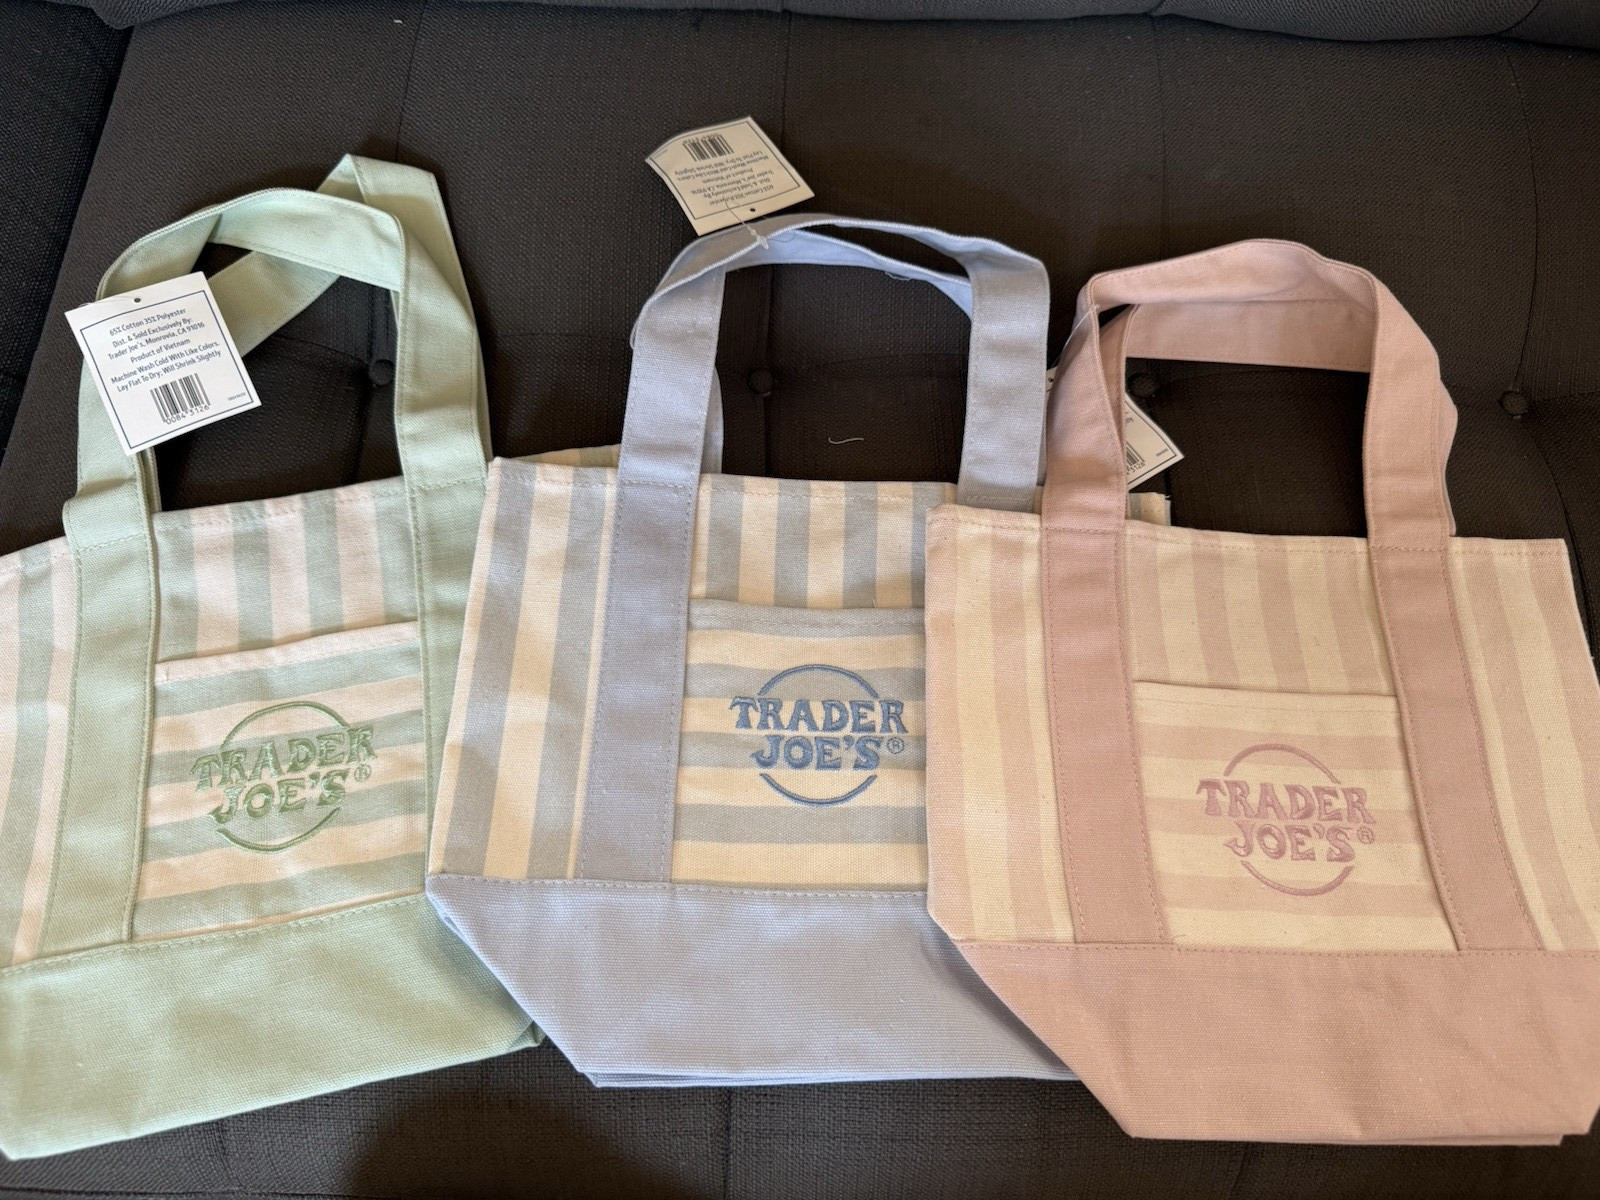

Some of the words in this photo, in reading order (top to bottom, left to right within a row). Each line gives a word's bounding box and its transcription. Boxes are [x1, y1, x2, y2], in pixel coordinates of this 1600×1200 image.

[732, 168, 753, 177] Product
[108, 349, 127, 360] Trader
[128, 342, 146, 353] Joe's,
[145, 332, 178, 345] Monrovia,
[186, 322, 205, 332] 91016
[109, 326, 122, 336] 65%
[121, 321, 144, 331] Cotton
[144, 316, 157, 324] 35%
[156, 309, 186, 320] Polyester
[112, 339, 127, 348] Dist.
[132, 330, 148, 339] Sold
[147, 321, 182, 335] Exclusively
[111, 370, 137, 384] Machine
[137, 363, 155, 373] Wash
[154, 357, 169, 366] Cold
[168, 352, 185, 361] With
[184, 348, 198, 356] Like
[198, 342, 220, 351] Colors.
[130, 350, 156, 363] Product
[156, 346, 163, 354] of
[163, 339, 191, 350] Vietnam
[117, 384, 129, 392] Lay
[128, 378, 141, 387] Flat
[162, 365, 175, 374] Will
[175, 358, 197, 369] Shrink
[196, 350, 221, 362] Slightly
[728, 696, 908, 734] TRADER
[190, 725, 378, 791] TRADER
[1196, 779, 1376, 824] TRADER
